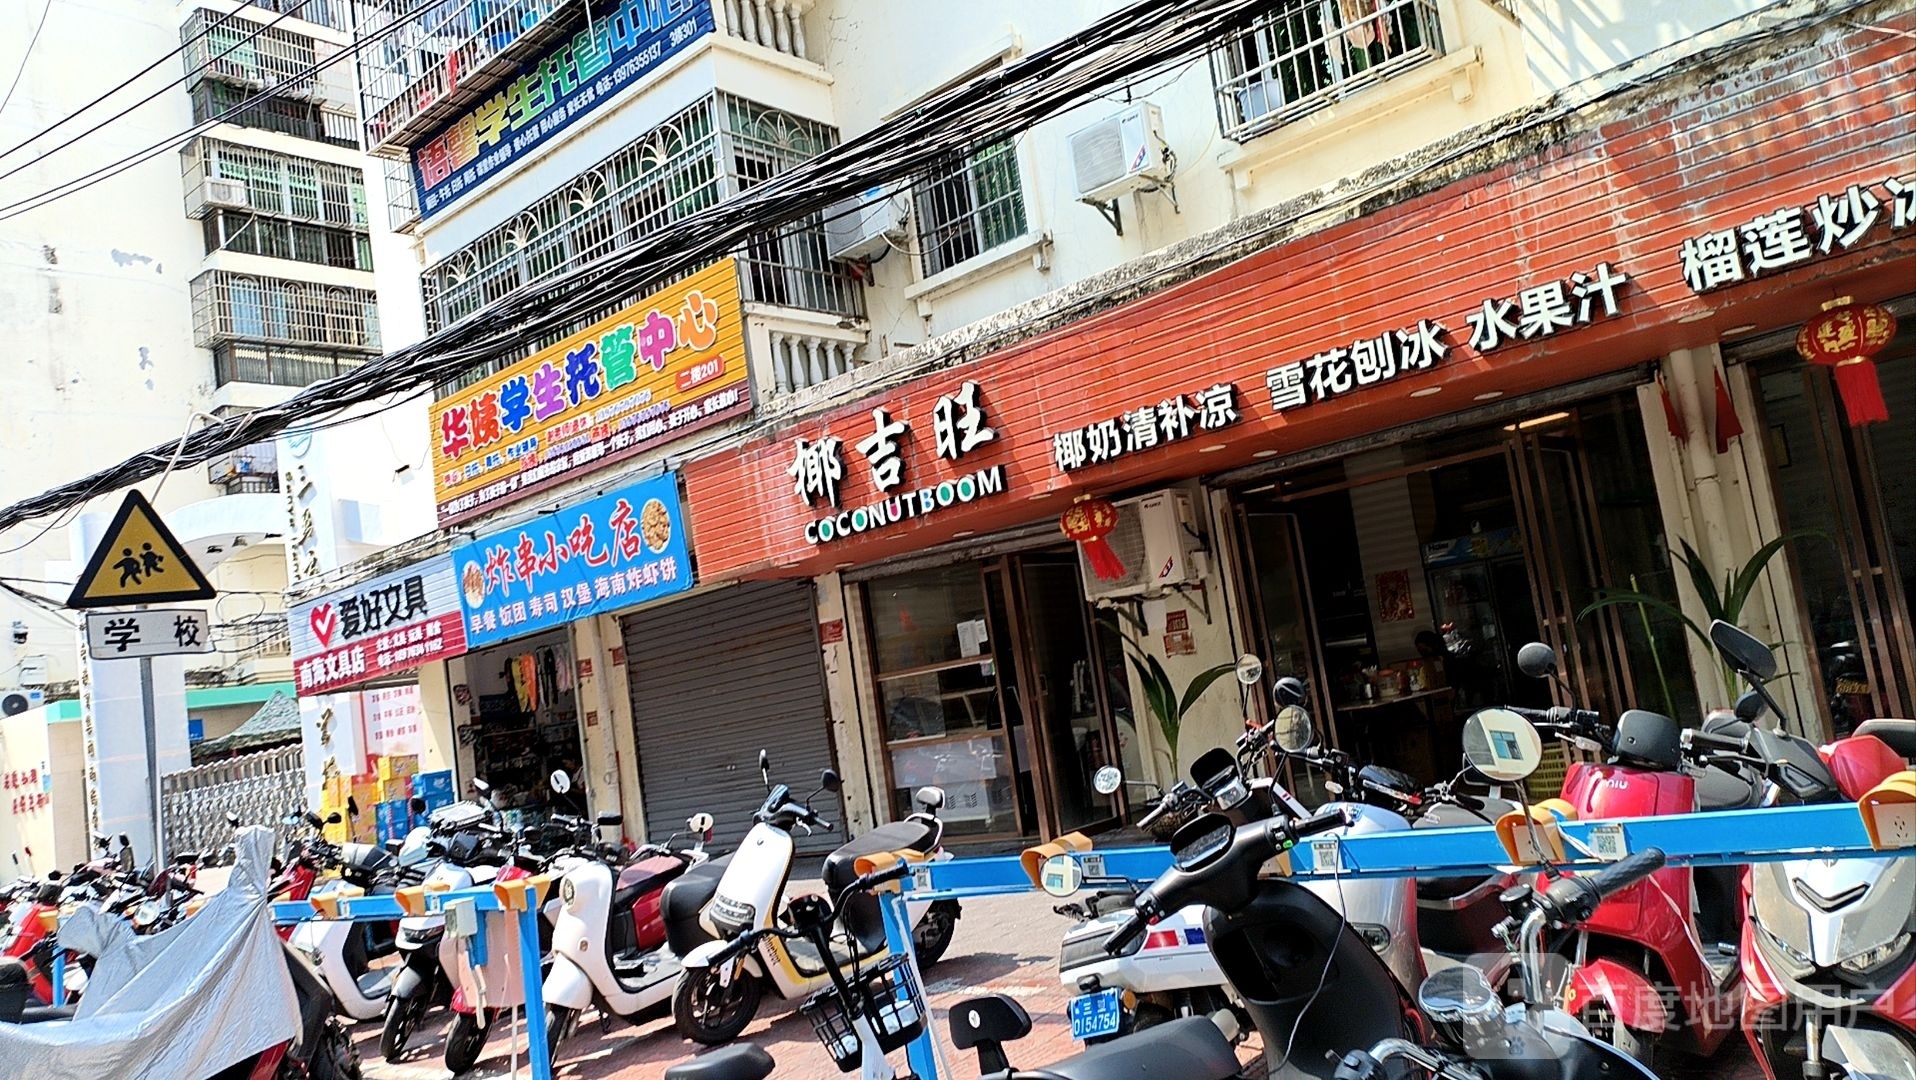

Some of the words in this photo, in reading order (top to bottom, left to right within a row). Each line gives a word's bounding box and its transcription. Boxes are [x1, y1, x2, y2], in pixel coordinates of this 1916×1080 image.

[1466, 262, 1631, 353] 水果汁
[679, 357, 720, 391] 二楼201
[1265, 318, 1451, 412] 雪花刨冰
[786, 379, 997, 508] 椰吉旺
[1053, 382, 1240, 472] 椰奶清补凉
[803, 465, 1004, 546] COCONUTBOOM
[484, 499, 642, 598] 炸串小吃店
[103, 614, 202, 652] 学校
[339, 574, 428, 640] 爱好文具
[470, 608, 498, 634] 早餐
[499, 604, 527, 627] 饭团
[529, 592, 559, 618] 寿司
[560, 582, 592, 609] 汉堡
[595, 556, 677, 600] 海南炸虾饼
[1073, 1011, 1117, 1036] 0154754
